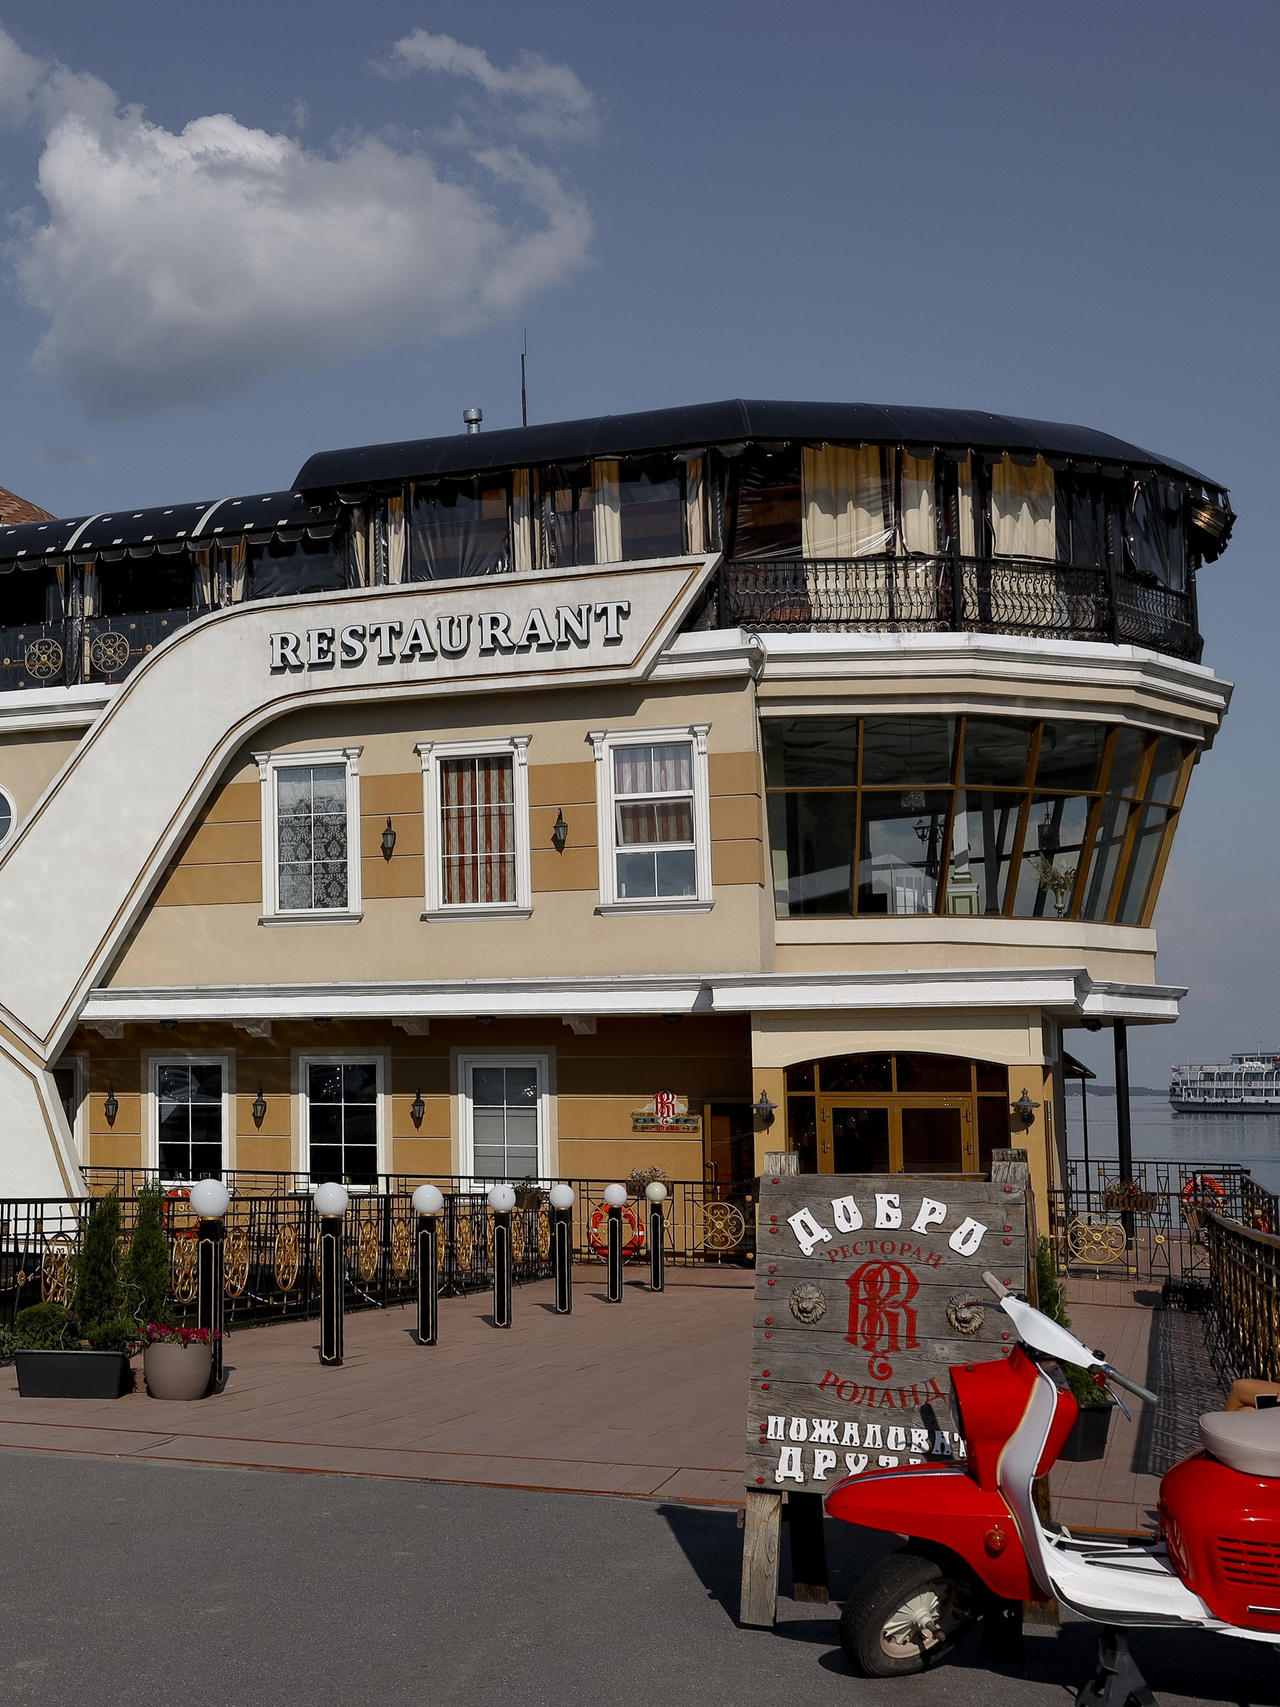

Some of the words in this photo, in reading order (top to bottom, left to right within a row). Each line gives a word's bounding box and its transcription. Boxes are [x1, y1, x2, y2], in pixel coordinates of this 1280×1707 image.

[270, 600, 631, 675] RESTAURANT
[787, 1193, 988, 1257] ДОБРО
[826, 1239, 944, 1270] РЕСТОРАН
[818, 1369, 947, 1409] РОЛАНД
[766, 1415, 968, 1458] ПОЖАЛОВАТ
[774, 1445, 923, 1484] ДРУ
